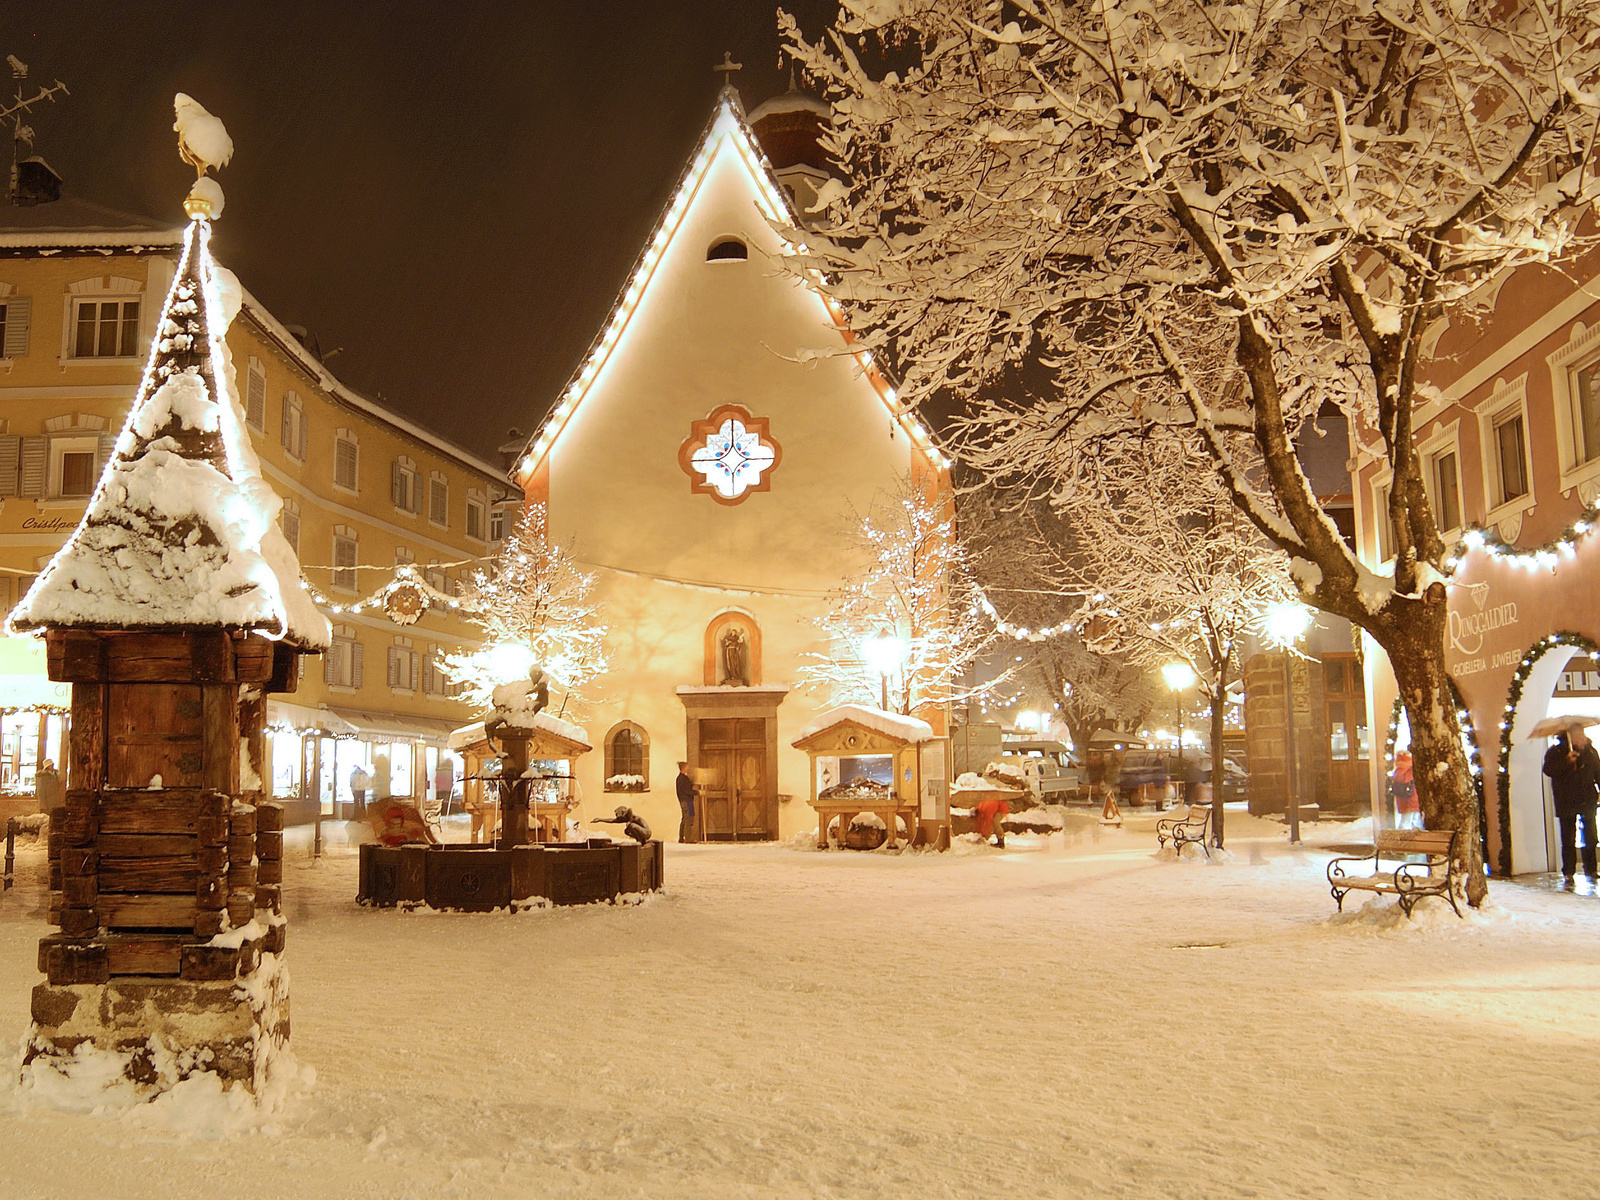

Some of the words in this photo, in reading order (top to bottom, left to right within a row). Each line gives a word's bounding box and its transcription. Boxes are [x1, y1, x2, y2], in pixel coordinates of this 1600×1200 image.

[1448, 602, 1518, 655] RUNGGALDIER
[1453, 657, 1487, 677] GIOIELLERIA
[1491, 648, 1522, 669] JUWELIER
